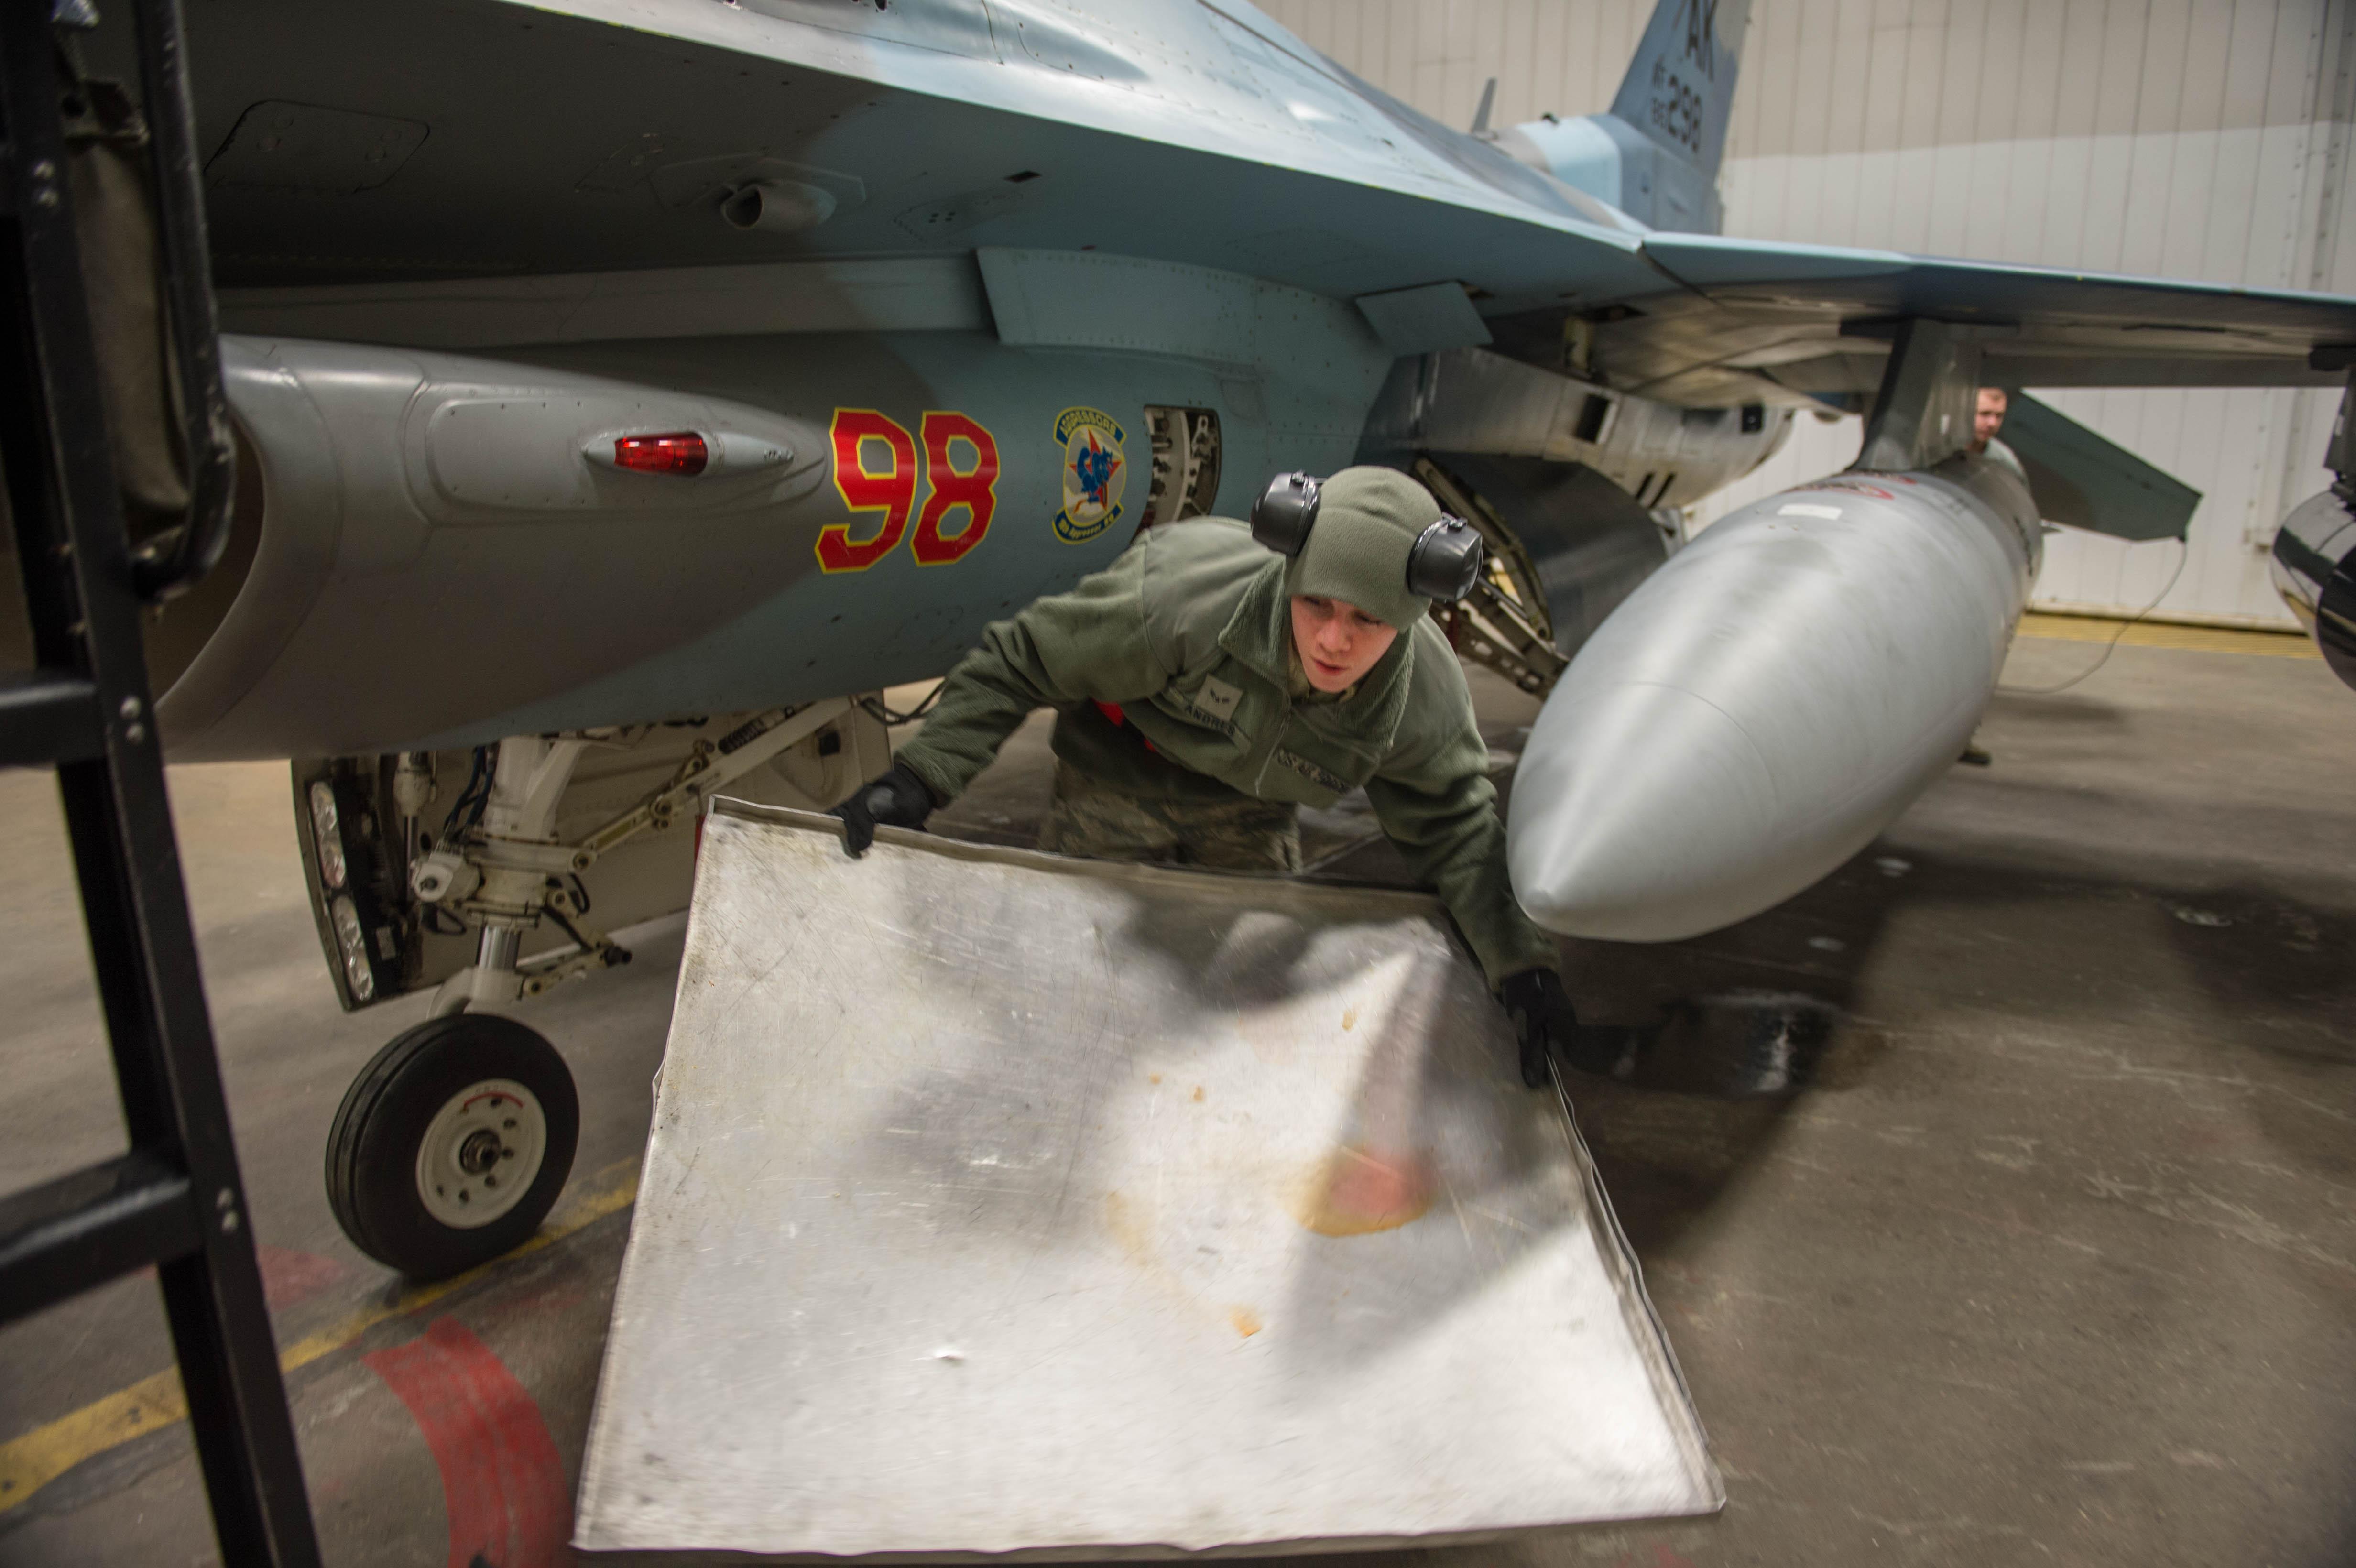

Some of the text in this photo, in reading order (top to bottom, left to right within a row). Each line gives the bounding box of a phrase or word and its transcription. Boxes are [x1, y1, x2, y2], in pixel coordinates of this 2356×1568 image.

[1685, 0, 1719, 82] AK
[1667, 73, 1703, 153] 298
[814, 407, 1000, 574] 98
[1184, 704, 1236, 736] ANDRES
